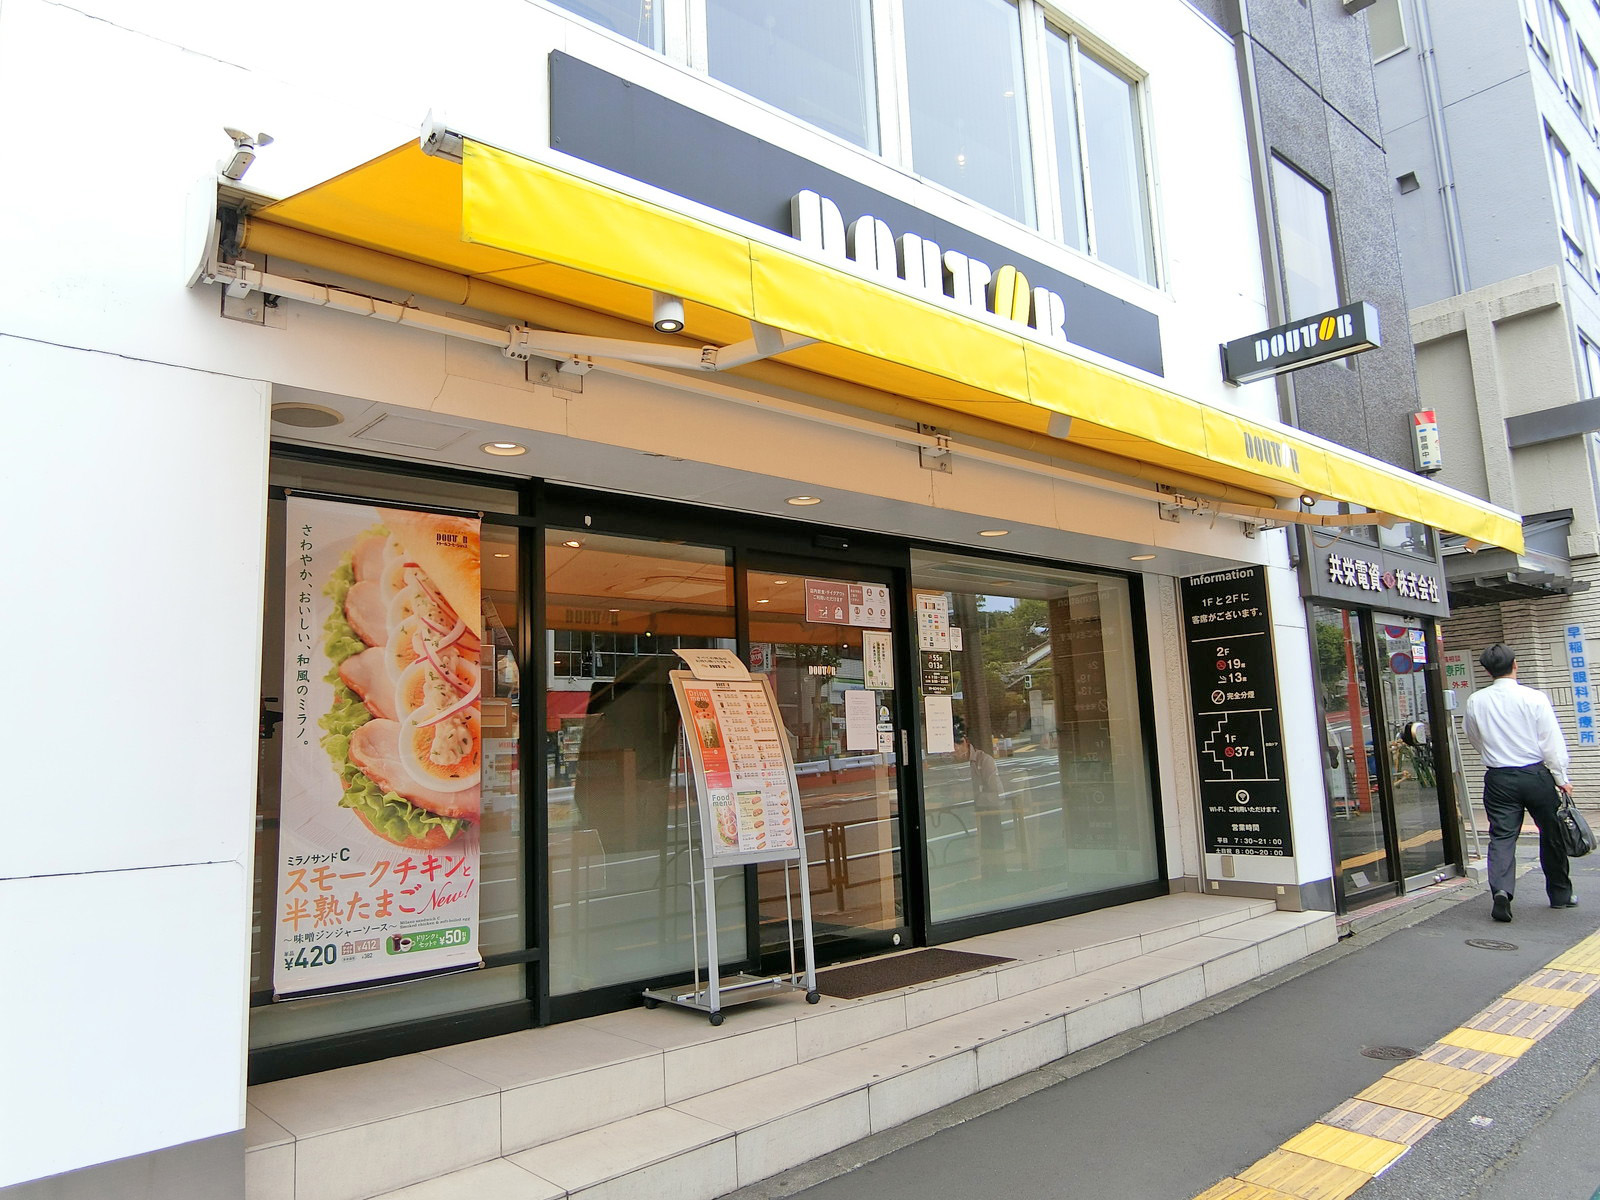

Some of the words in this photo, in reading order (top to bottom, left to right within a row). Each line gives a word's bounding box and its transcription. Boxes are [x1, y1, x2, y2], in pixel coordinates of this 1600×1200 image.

[1254, 313, 1353, 363] DOUTOR
[1243, 431, 1300, 474] DOUTOR
[1190, 568, 1254, 586] information
[1328, 552, 1382, 592] 共栄電資
[1395, 568, 1440, 603] 株式会社
[1191, 607, 1263, 625] 客席がございます。
[296, 524, 313, 745] さわやか、おいしい、和風のミラノ。
[1216, 647, 1230, 657] 2F
[808, 664, 836, 677] DOUTOR
[1567, 626, 1595, 743] 早稲田眼科診療所
[1224, 734, 1237, 744] 1F
[712, 794, 730, 802] Food
[1231, 823, 1260, 832] 営業時間
[284, 854, 472, 895] スモークチキンと
[282, 883, 423, 932] 半熟たまご
[416, 878, 475, 914] New!
[284, 943, 338, 971] ¥420
